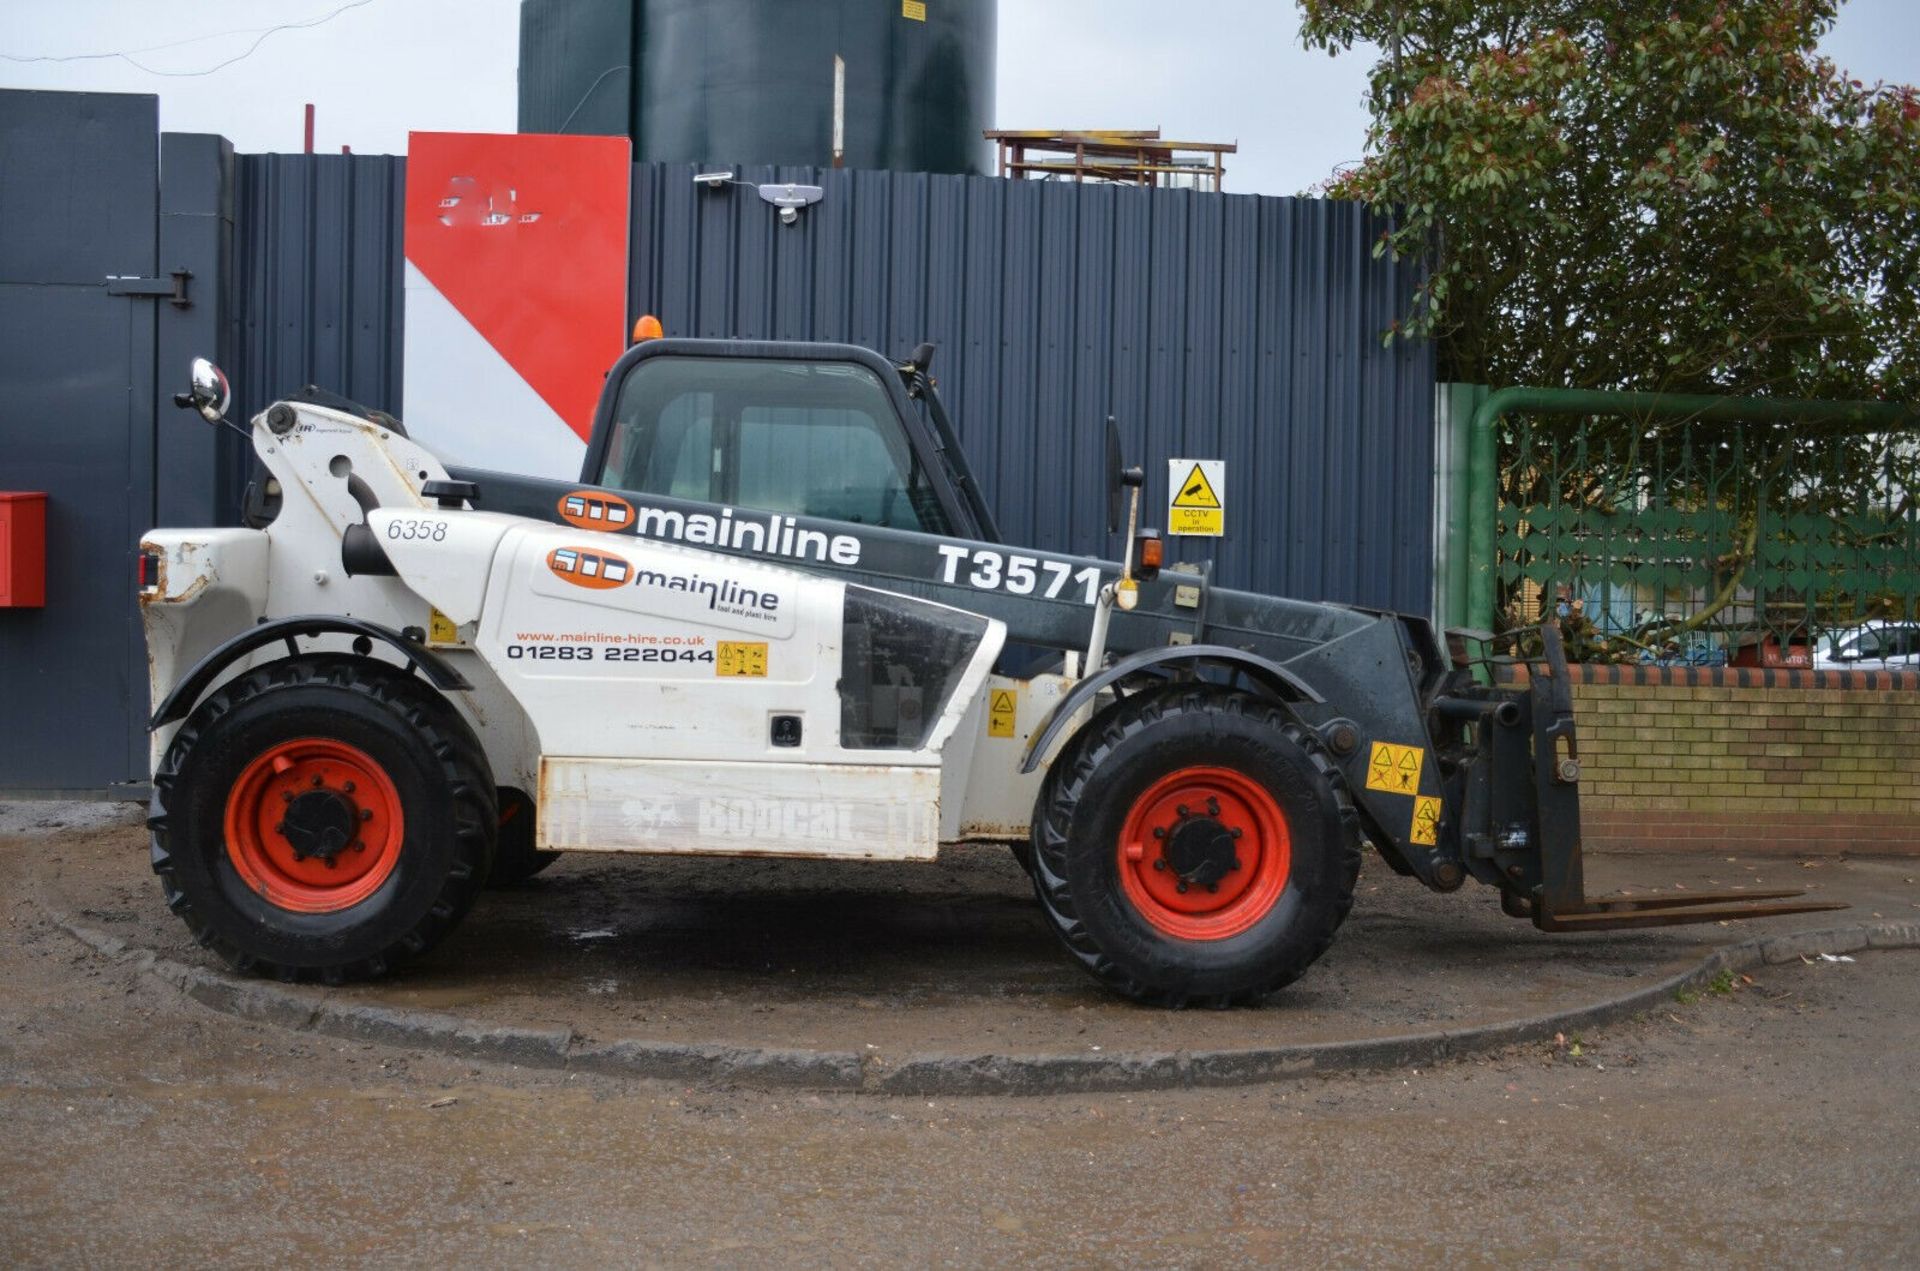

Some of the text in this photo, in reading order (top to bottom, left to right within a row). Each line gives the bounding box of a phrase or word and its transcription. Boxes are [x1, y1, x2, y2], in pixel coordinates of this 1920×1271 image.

[1183, 509, 1209, 518] CCTV
[388, 519, 458, 541] 6358
[637, 508, 861, 565] mainline
[938, 544, 1101, 605] T3571
[635, 569, 779, 610] mainline
[732, 608, 744, 616] and
[516, 632, 705, 646] www.mainline-hire.co.uk
[507, 645, 714, 663] 01283 222044
